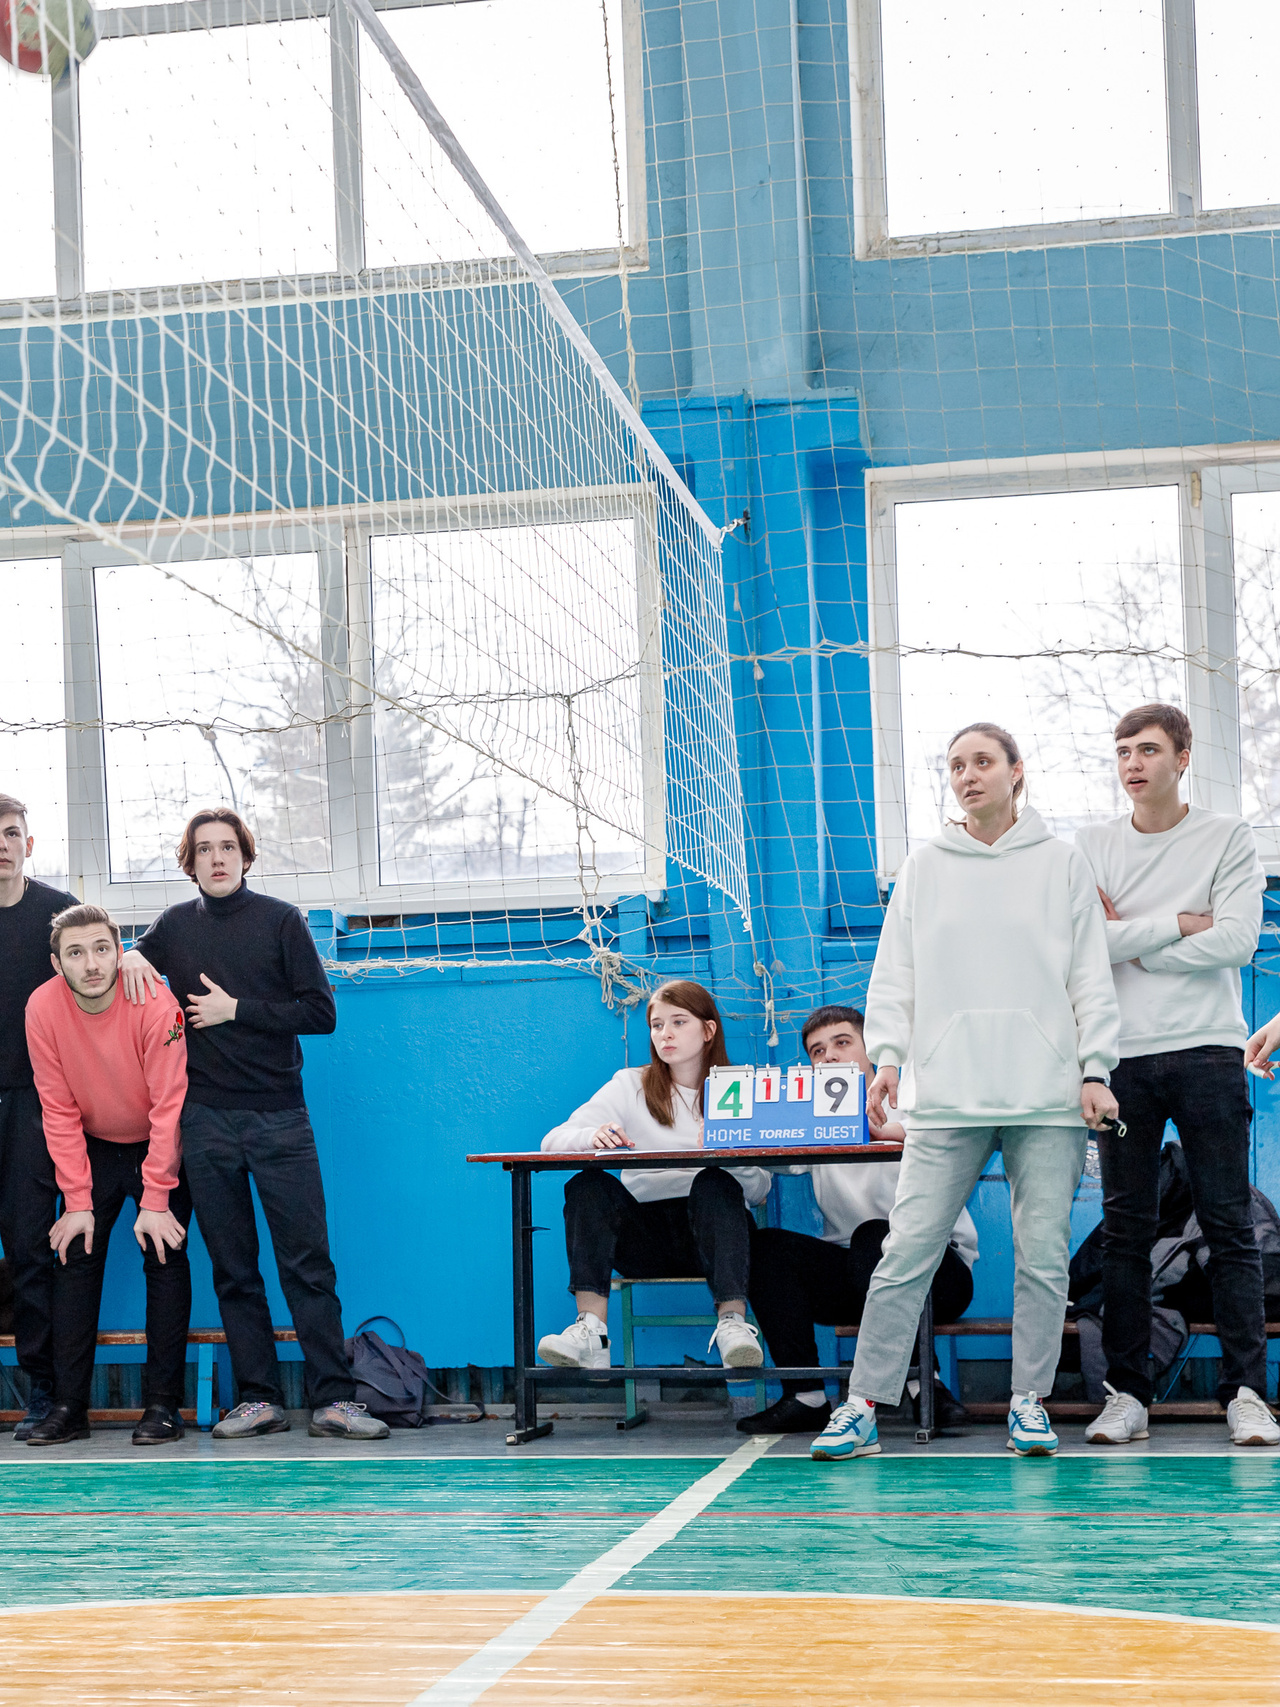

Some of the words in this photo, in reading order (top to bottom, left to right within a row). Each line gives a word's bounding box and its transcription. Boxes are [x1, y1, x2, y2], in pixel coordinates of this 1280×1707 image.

[717, 1081, 743, 1117] 4
[762, 1078, 772, 1100] 1
[794, 1077, 804, 1100] 1
[824, 1077, 848, 1113] 9
[707, 1128, 752, 1142] HOME
[759, 1128, 805, 1139] TORRES
[814, 1125, 859, 1140] GUEST
